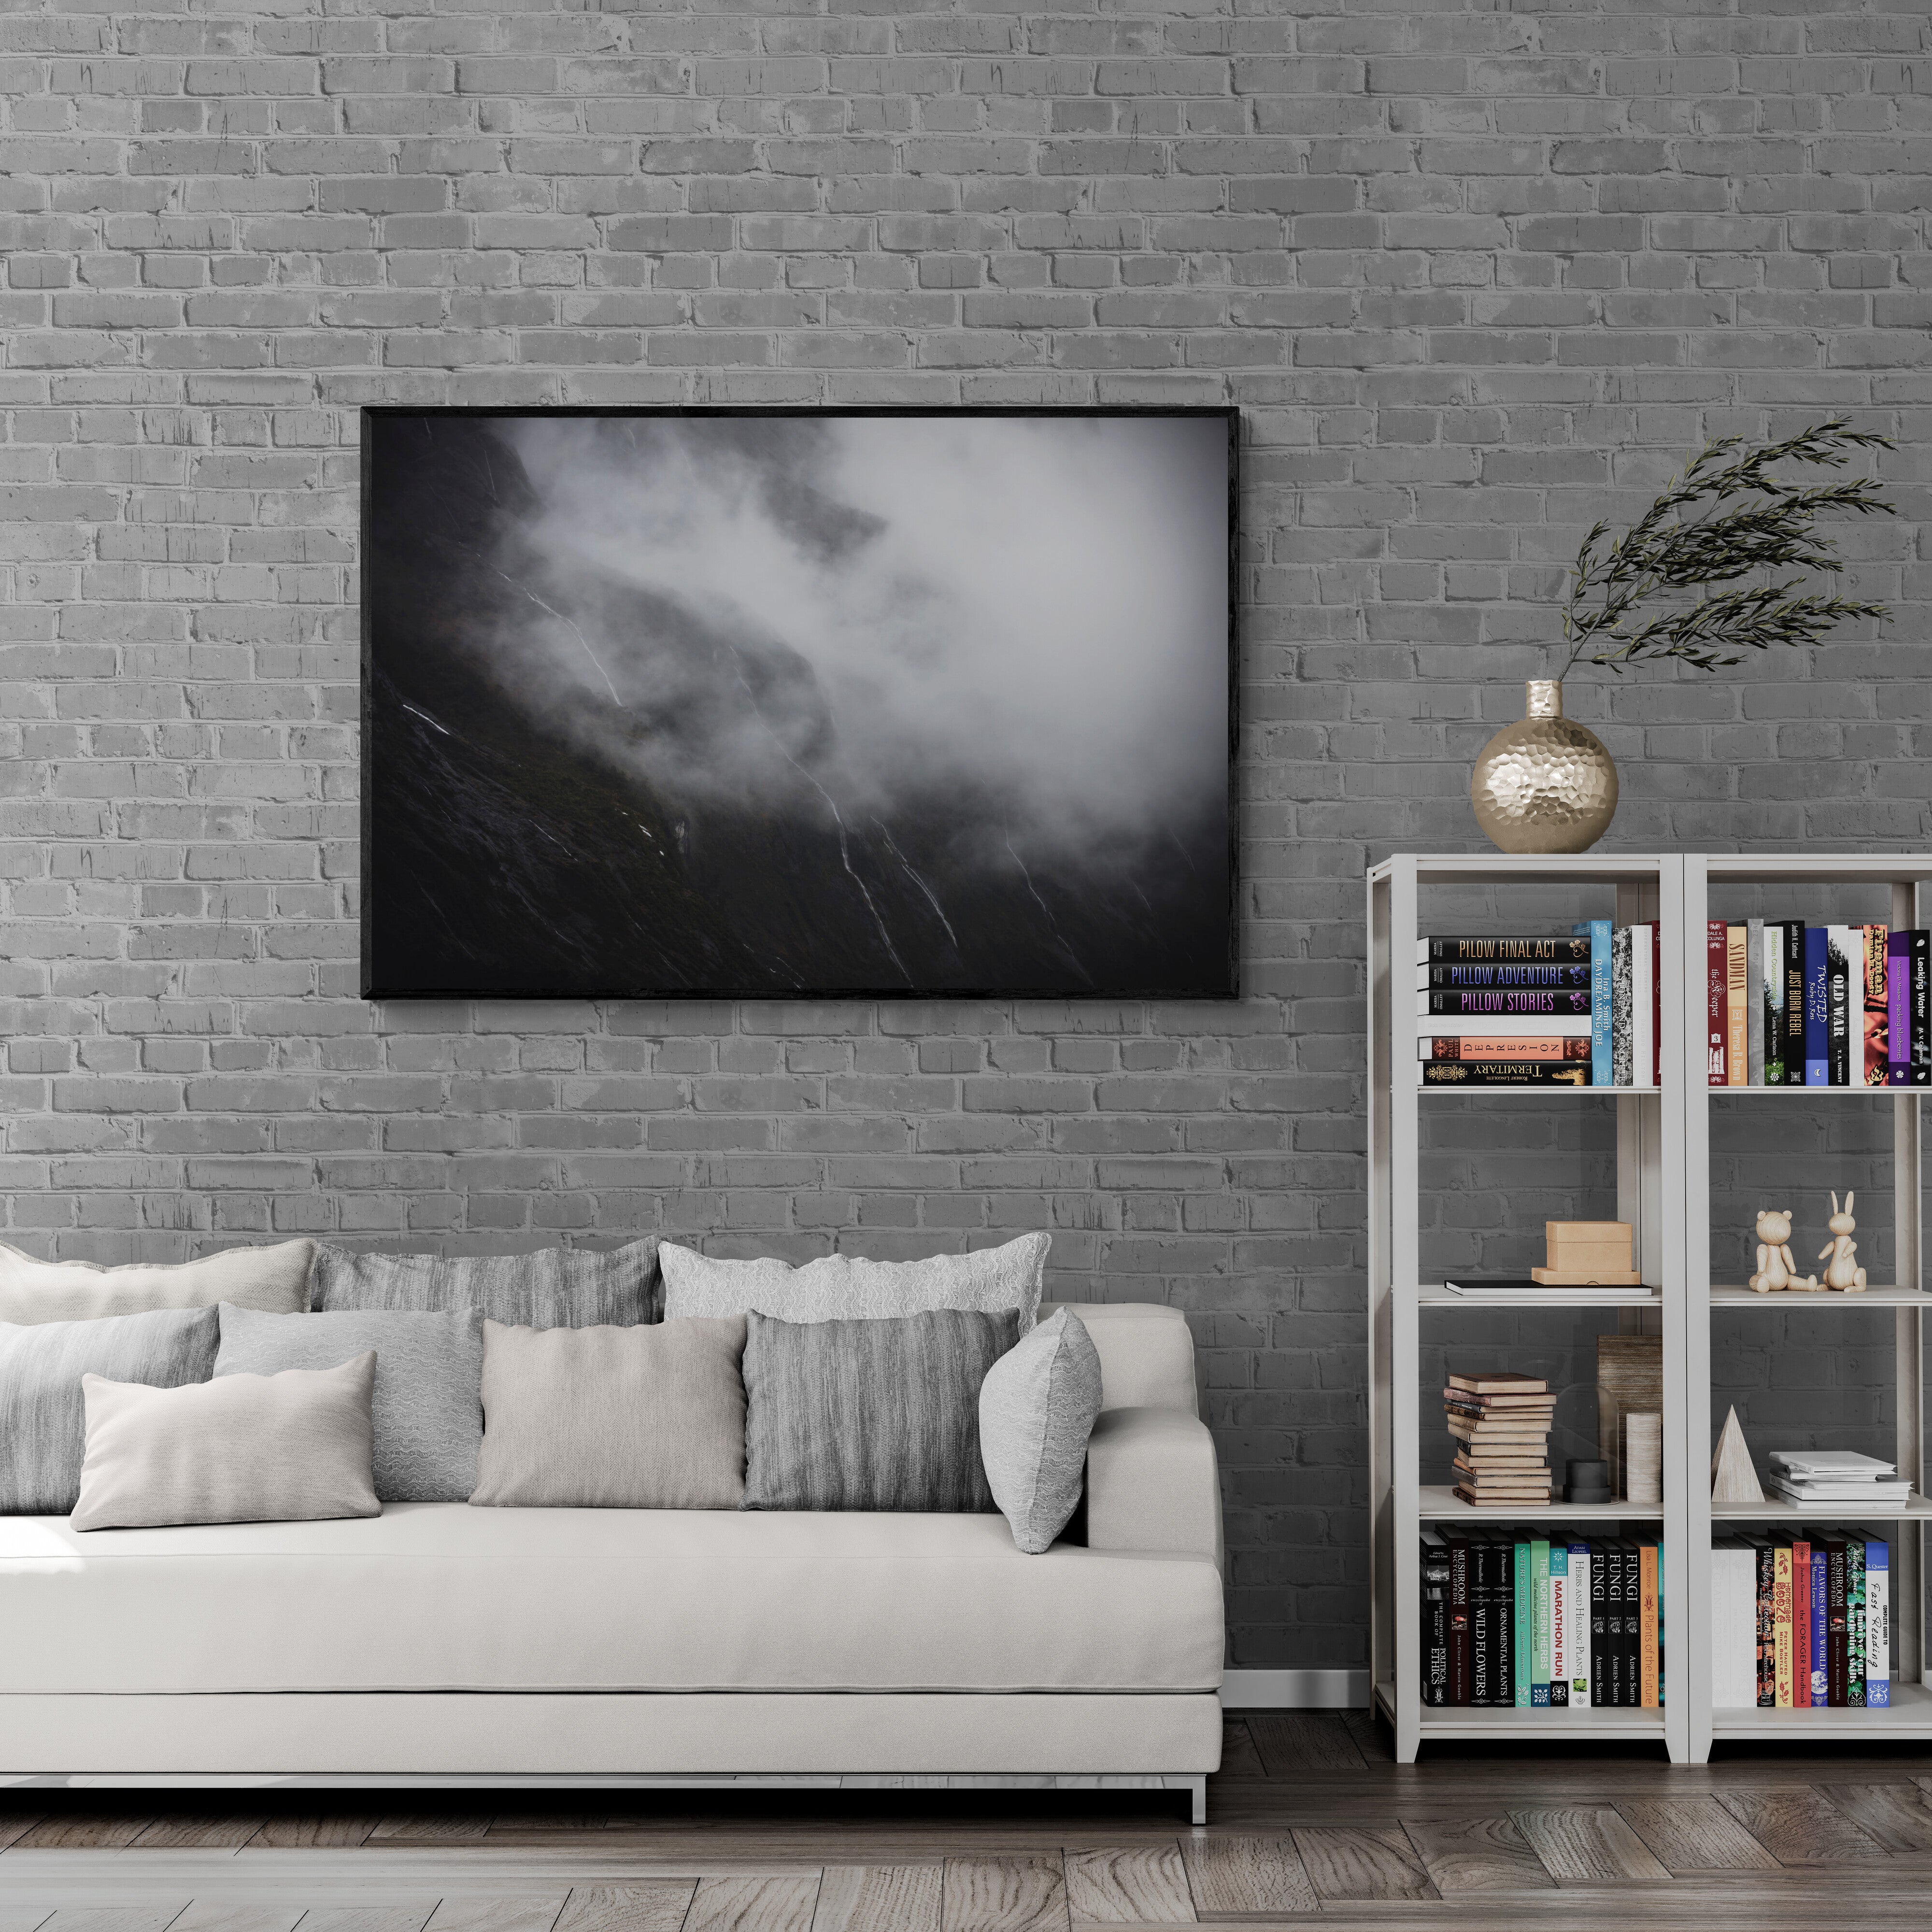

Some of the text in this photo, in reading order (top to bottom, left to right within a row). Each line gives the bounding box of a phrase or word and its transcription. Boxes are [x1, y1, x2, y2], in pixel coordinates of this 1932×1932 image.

[1460, 940, 1556, 957] PILOW FINAL ACT
[1875, 929, 1884, 994] Fireman
[1452, 966, 1563, 984] PILLOW ADVENTURE
[1711, 969, 1719, 980] the
[1729, 944, 1745, 991] SANDMAN
[1916, 957, 1925, 990] Leaking
[1462, 993, 1554, 1010] PILLOW STORIES
[1789, 970, 1802, 1036] JUST BORN REBEL
[1807, 982, 1816, 998] Ruby
[1817, 965, 1827, 1023] TWISTED
[1833, 974, 1844, 1037] OLD WAR
[1593, 1031, 1603, 1047] JOE
[1733, 1025, 1743, 1050] Theresa
[1474, 1065, 1543, 1077] TERMITARY
[1733, 1060, 1743, 1080] Brown
[1576, 1561, 1584, 1587] HERBS
[1593, 1554, 1604, 1601] FUNGI
[1610, 1554, 1621, 1601] FUNGI
[1627, 1554, 1638, 1601] FUNGI
[1761, 1548, 1773, 1638] Whiskey Collection
[1819, 1605, 1826, 1617] OF
[1576, 1608, 1584, 1644] HEALING
[1848, 1604, 1857, 1655] gardening
[1868, 1583, 1881, 1667] Fast Reading
[1432, 1648, 1440, 1685] ETHICS
[1476, 1608, 1486, 1696] WILD FLOWERS
[1576, 1647, 1585, 1676] PLANTS
[1645, 1615, 1654, 1704] Plants of the Future
